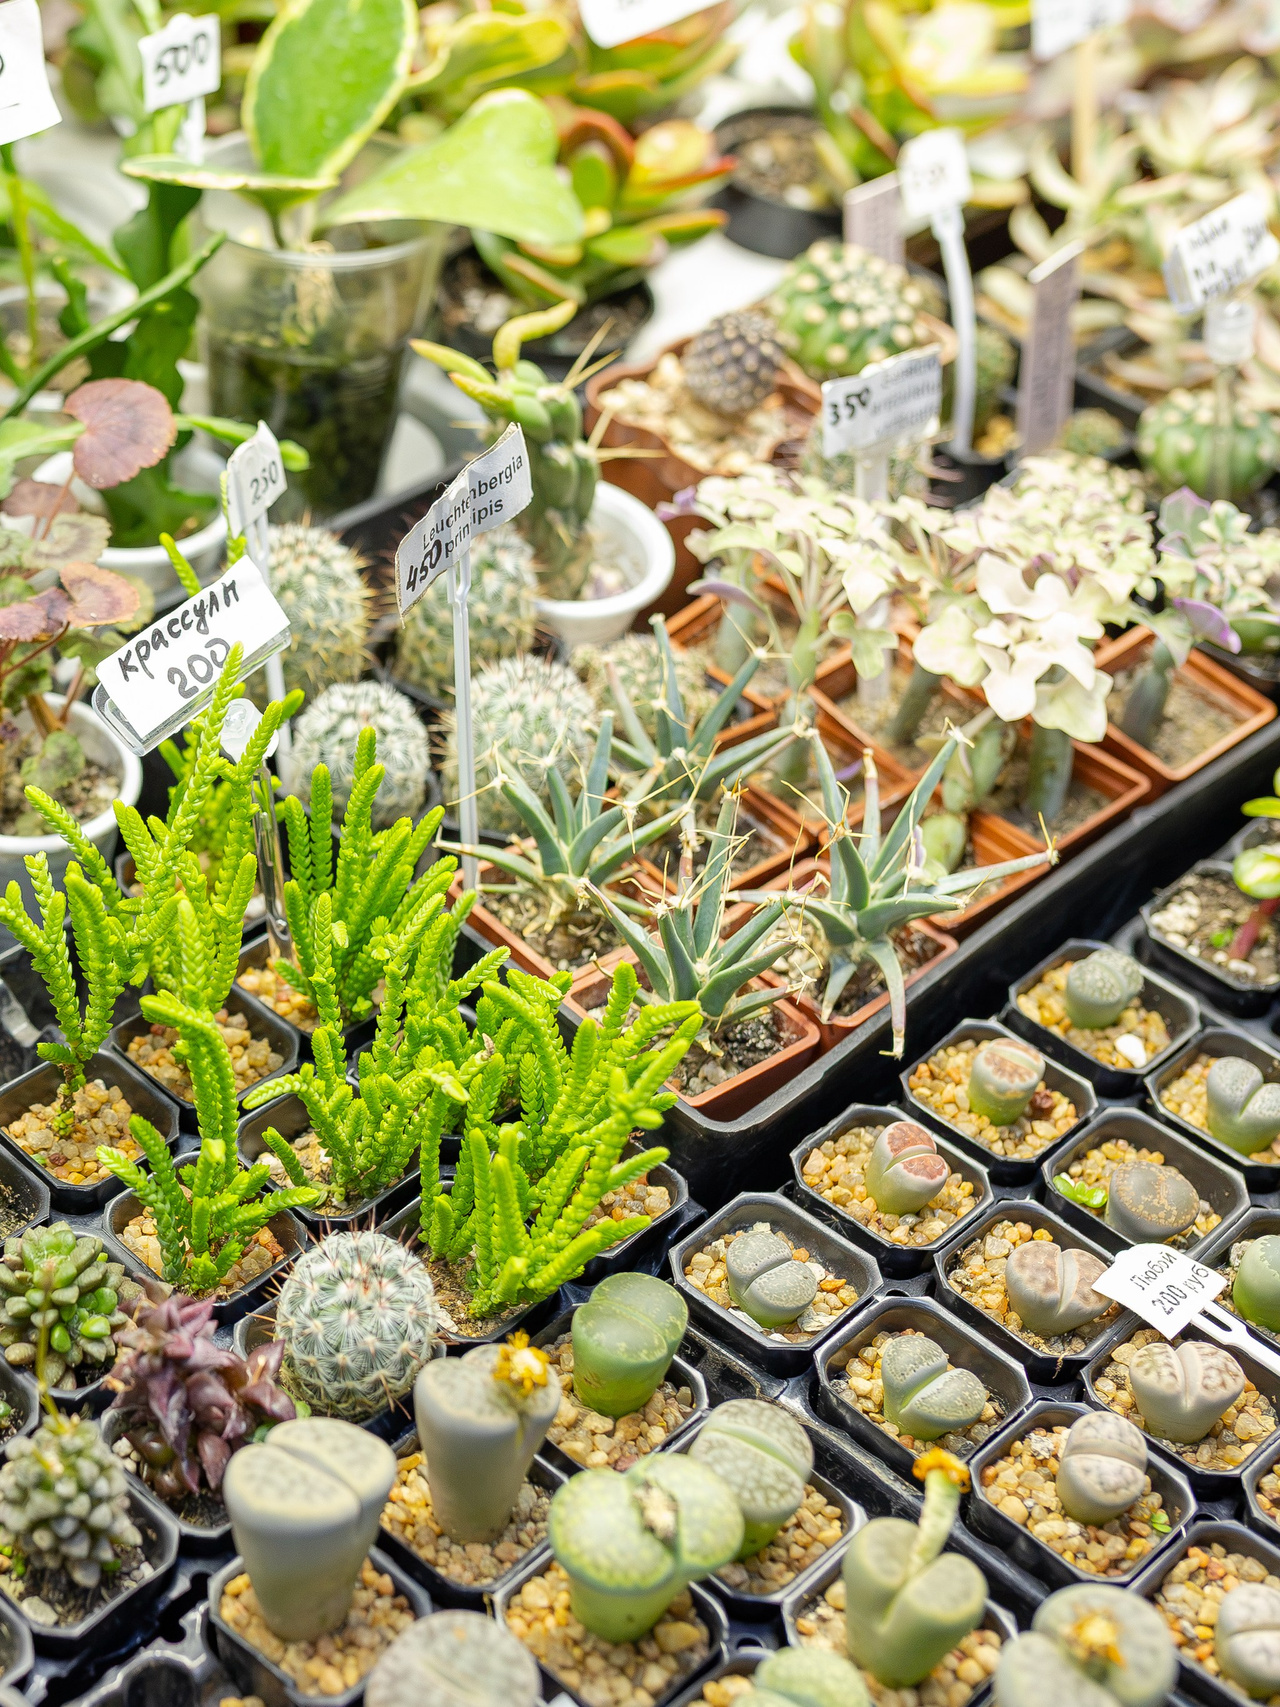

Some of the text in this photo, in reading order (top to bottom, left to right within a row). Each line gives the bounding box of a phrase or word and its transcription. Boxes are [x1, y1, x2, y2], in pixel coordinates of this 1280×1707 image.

[154, 32, 210, 87] 500
[829, 385, 870, 426] 350
[405, 498, 504, 592] 450 prinipis
[167, 637, 231, 699] 200
[1151, 1284, 1189, 1316] 200
